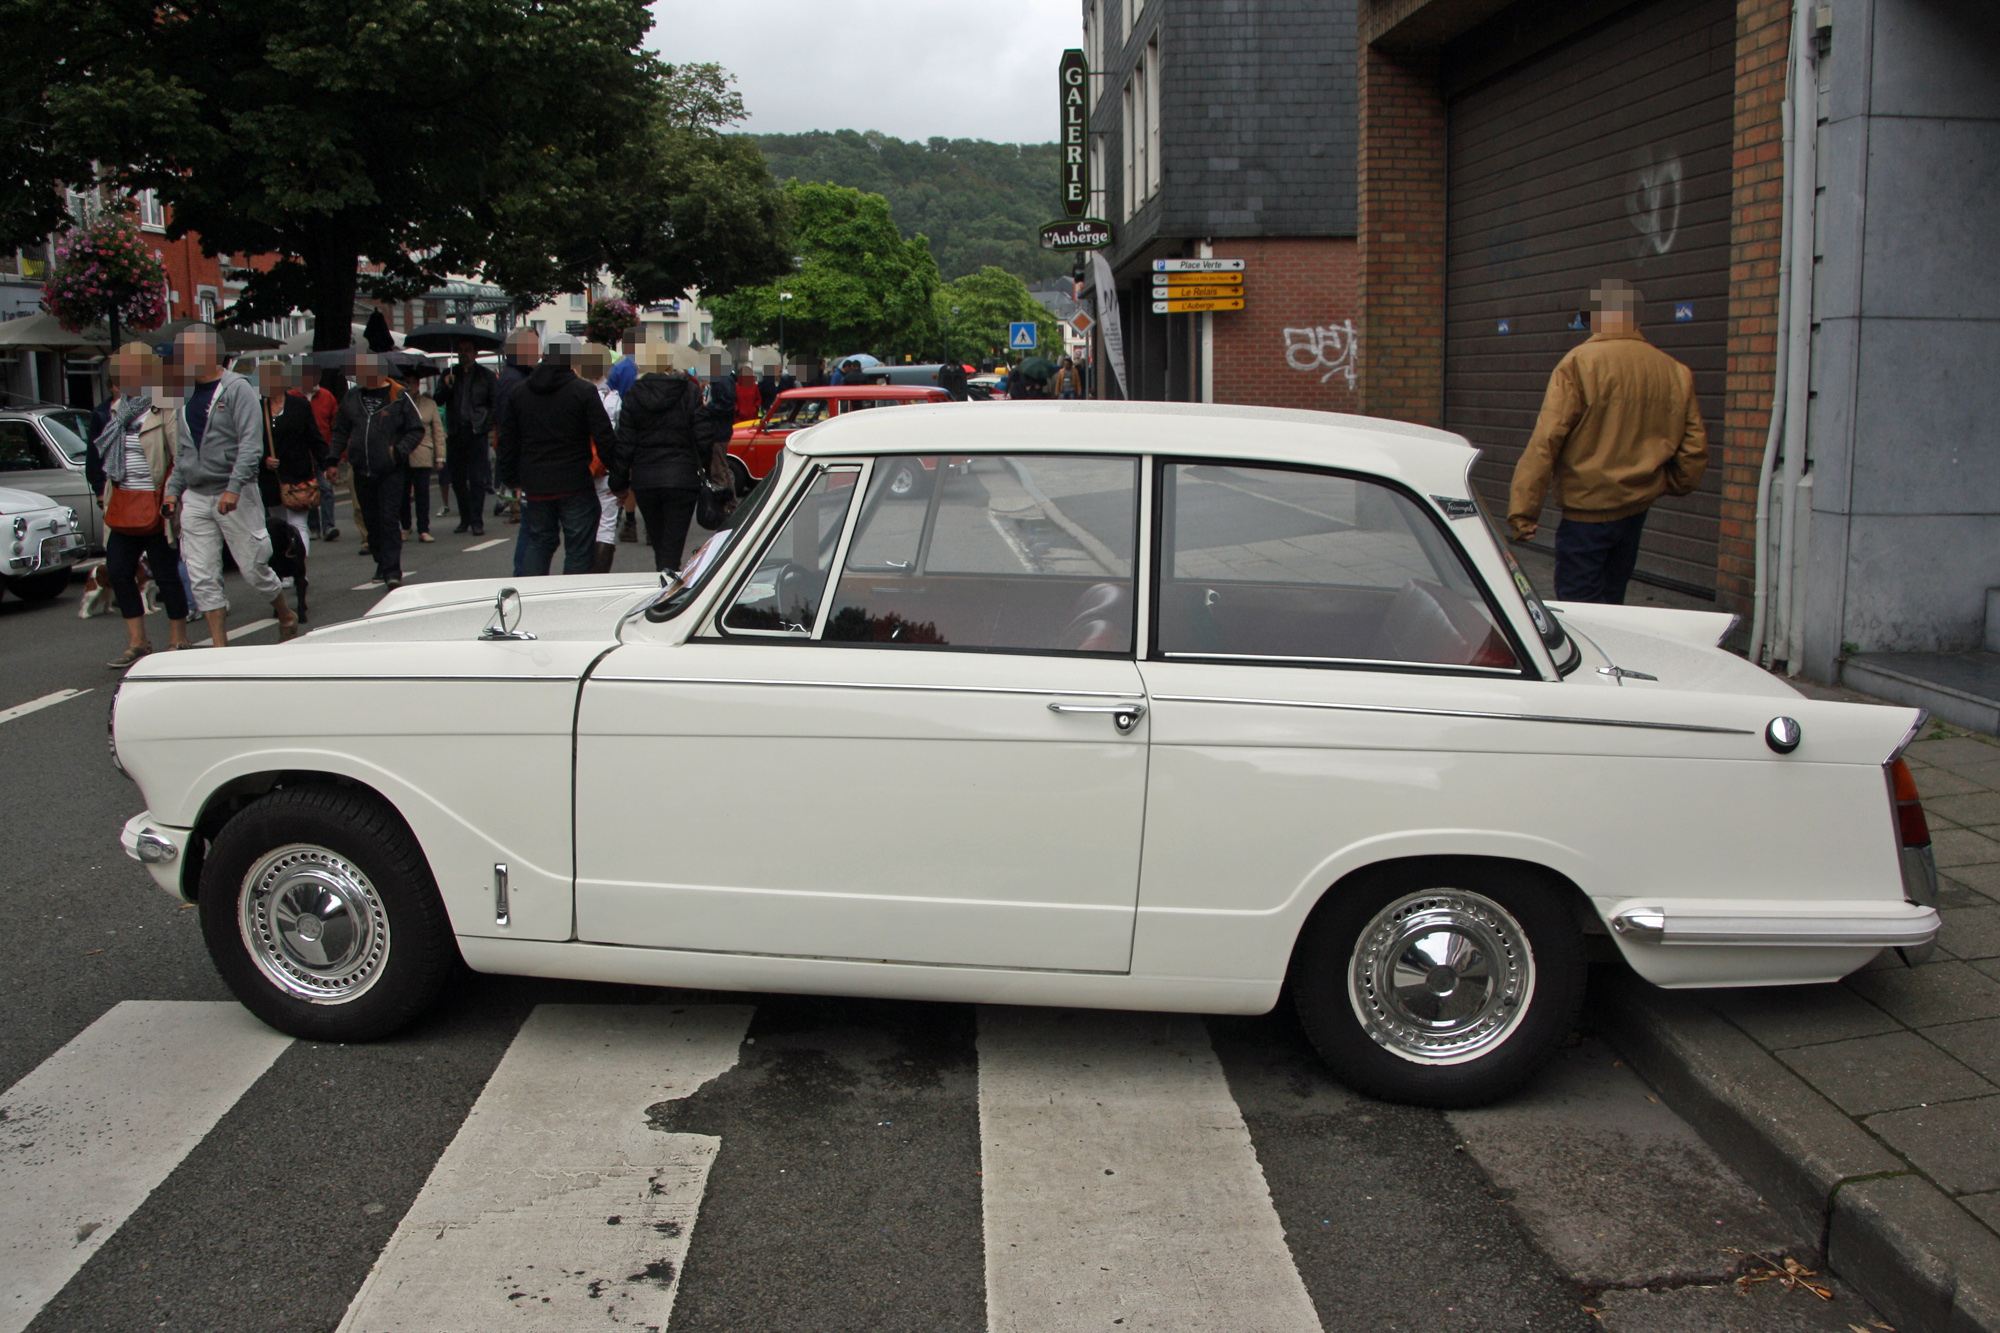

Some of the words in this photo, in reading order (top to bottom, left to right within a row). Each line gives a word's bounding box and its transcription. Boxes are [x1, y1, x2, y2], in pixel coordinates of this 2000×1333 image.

[1065, 67, 1083, 201] GALERIE
[1077, 221, 1091, 232] de
[1180, 261, 1201, 269] Place
[1203, 261, 1222, 269] Verte
[1181, 288, 1192, 296] Le
[1194, 287, 1218, 296] Relais
[1181, 302, 1215, 312] L'Auberge
[1446, 502, 1474, 513] Triumph
